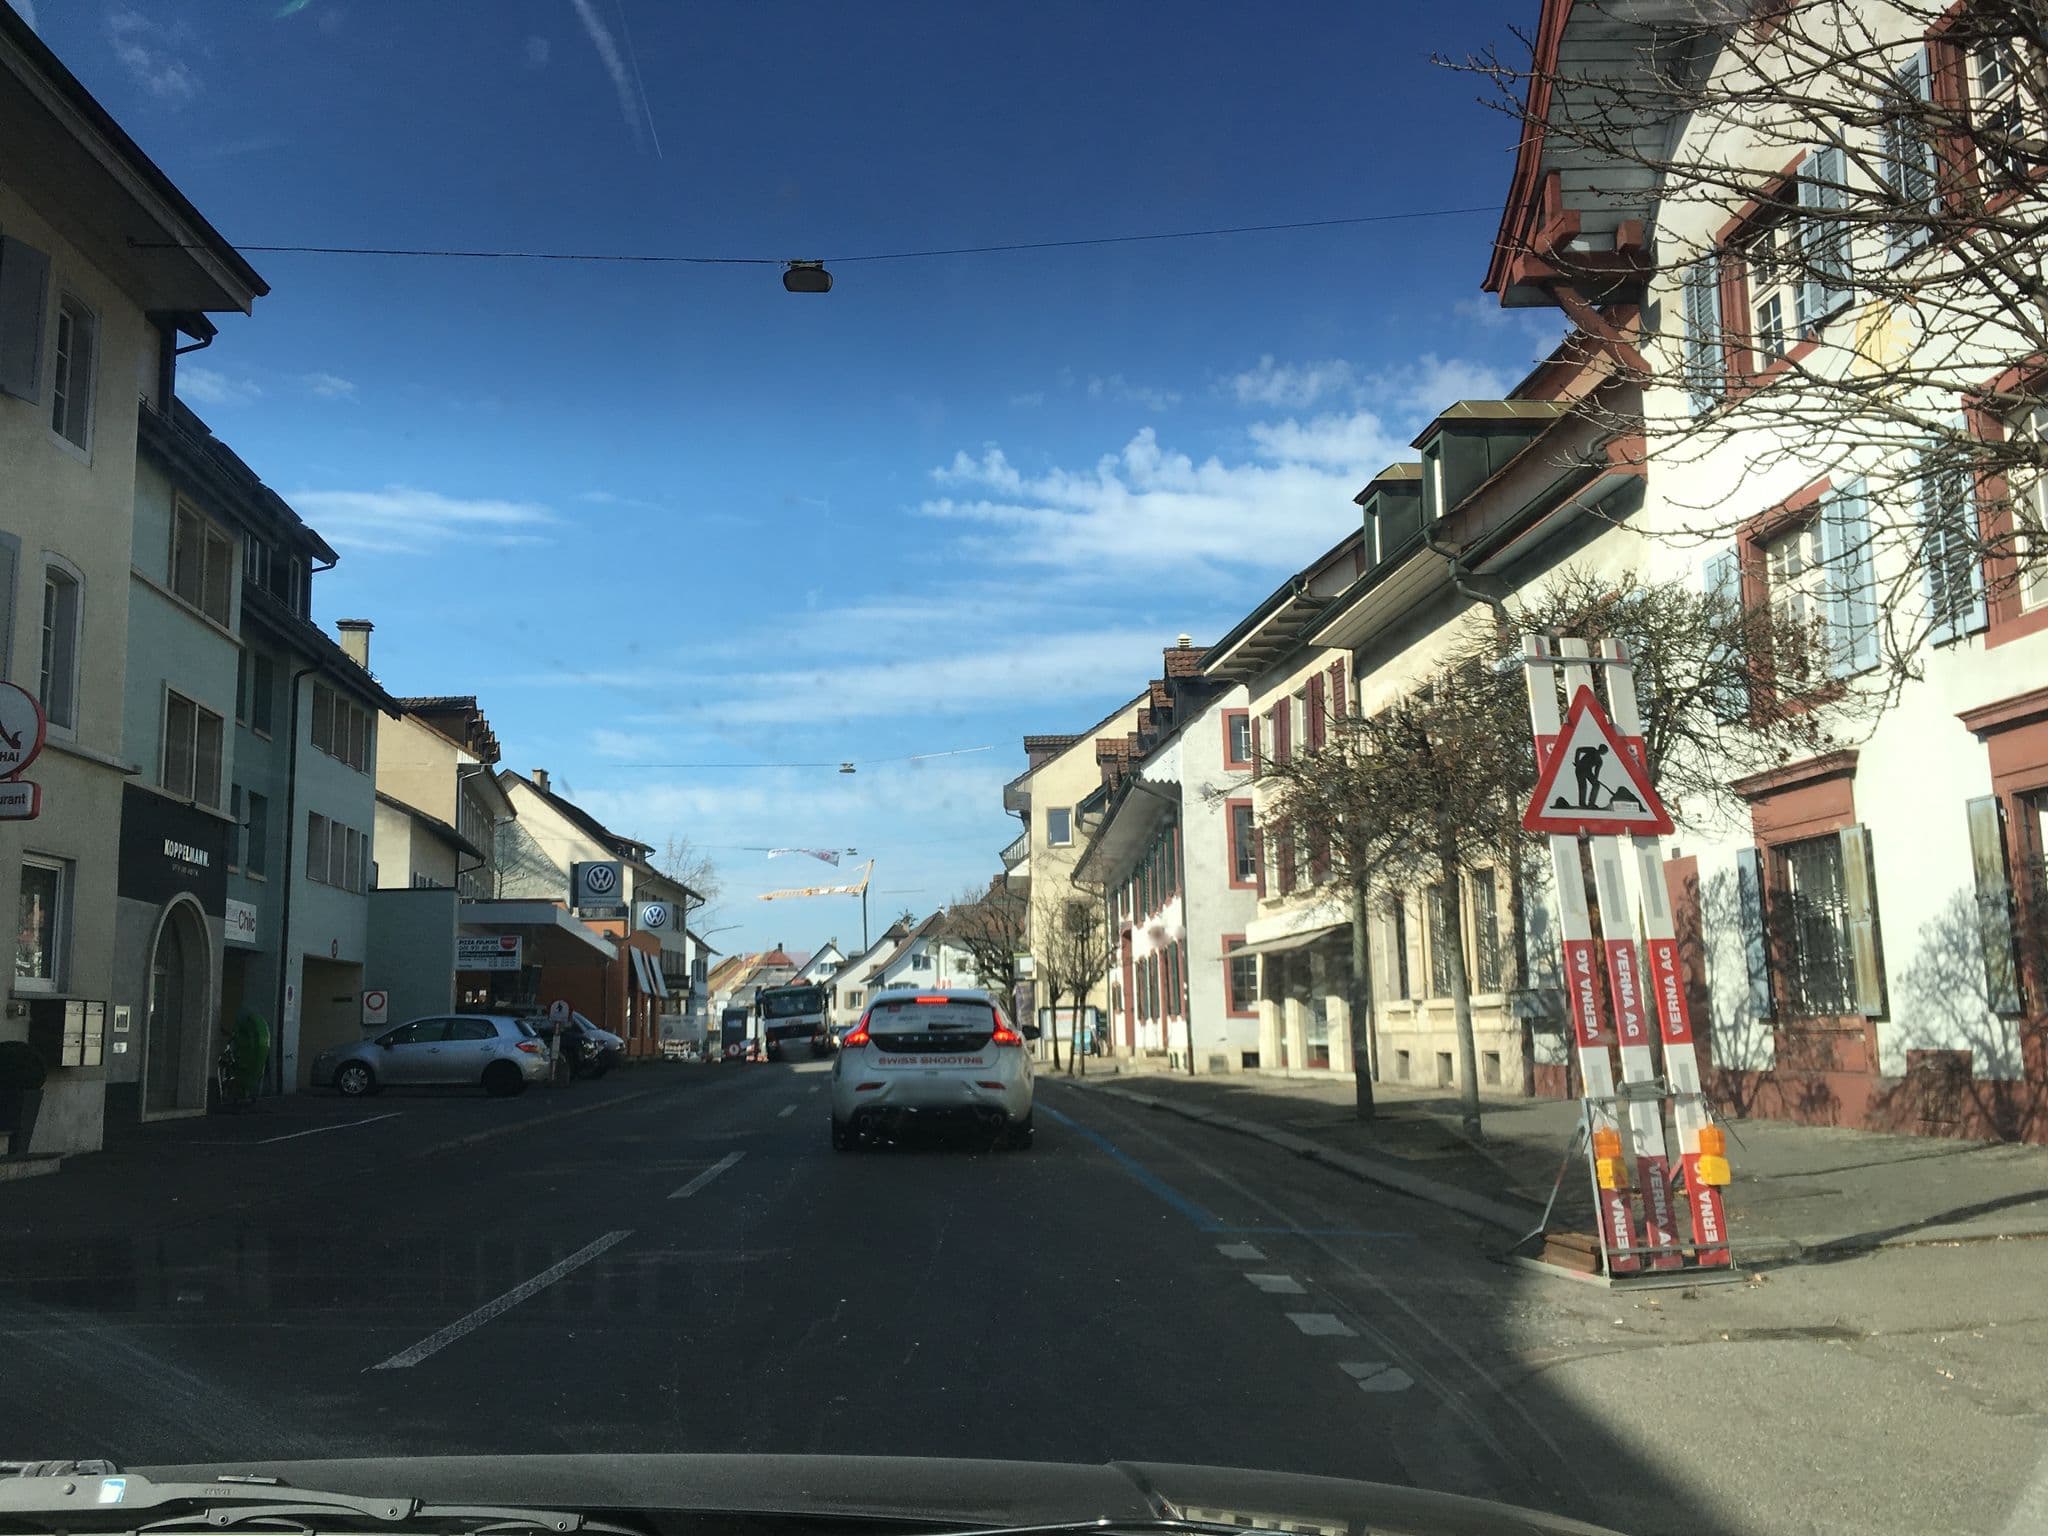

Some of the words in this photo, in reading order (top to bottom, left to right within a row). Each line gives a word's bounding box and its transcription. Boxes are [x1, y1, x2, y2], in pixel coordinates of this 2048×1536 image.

[238, 909, 256, 932] Chic
[1576, 949, 1591, 975] AG
[1616, 948, 1635, 1009] VERNA
[1659, 947, 1674, 972] AG
[1580, 978, 1599, 1040] VERNA
[1625, 1011, 1640, 1037] AG
[1664, 975, 1684, 1035] VERNA
[879, 1056, 917, 1065] SWISS
[1648, 1162, 1669, 1228] VERNA
[1699, 1191, 1719, 1246] ERNA
